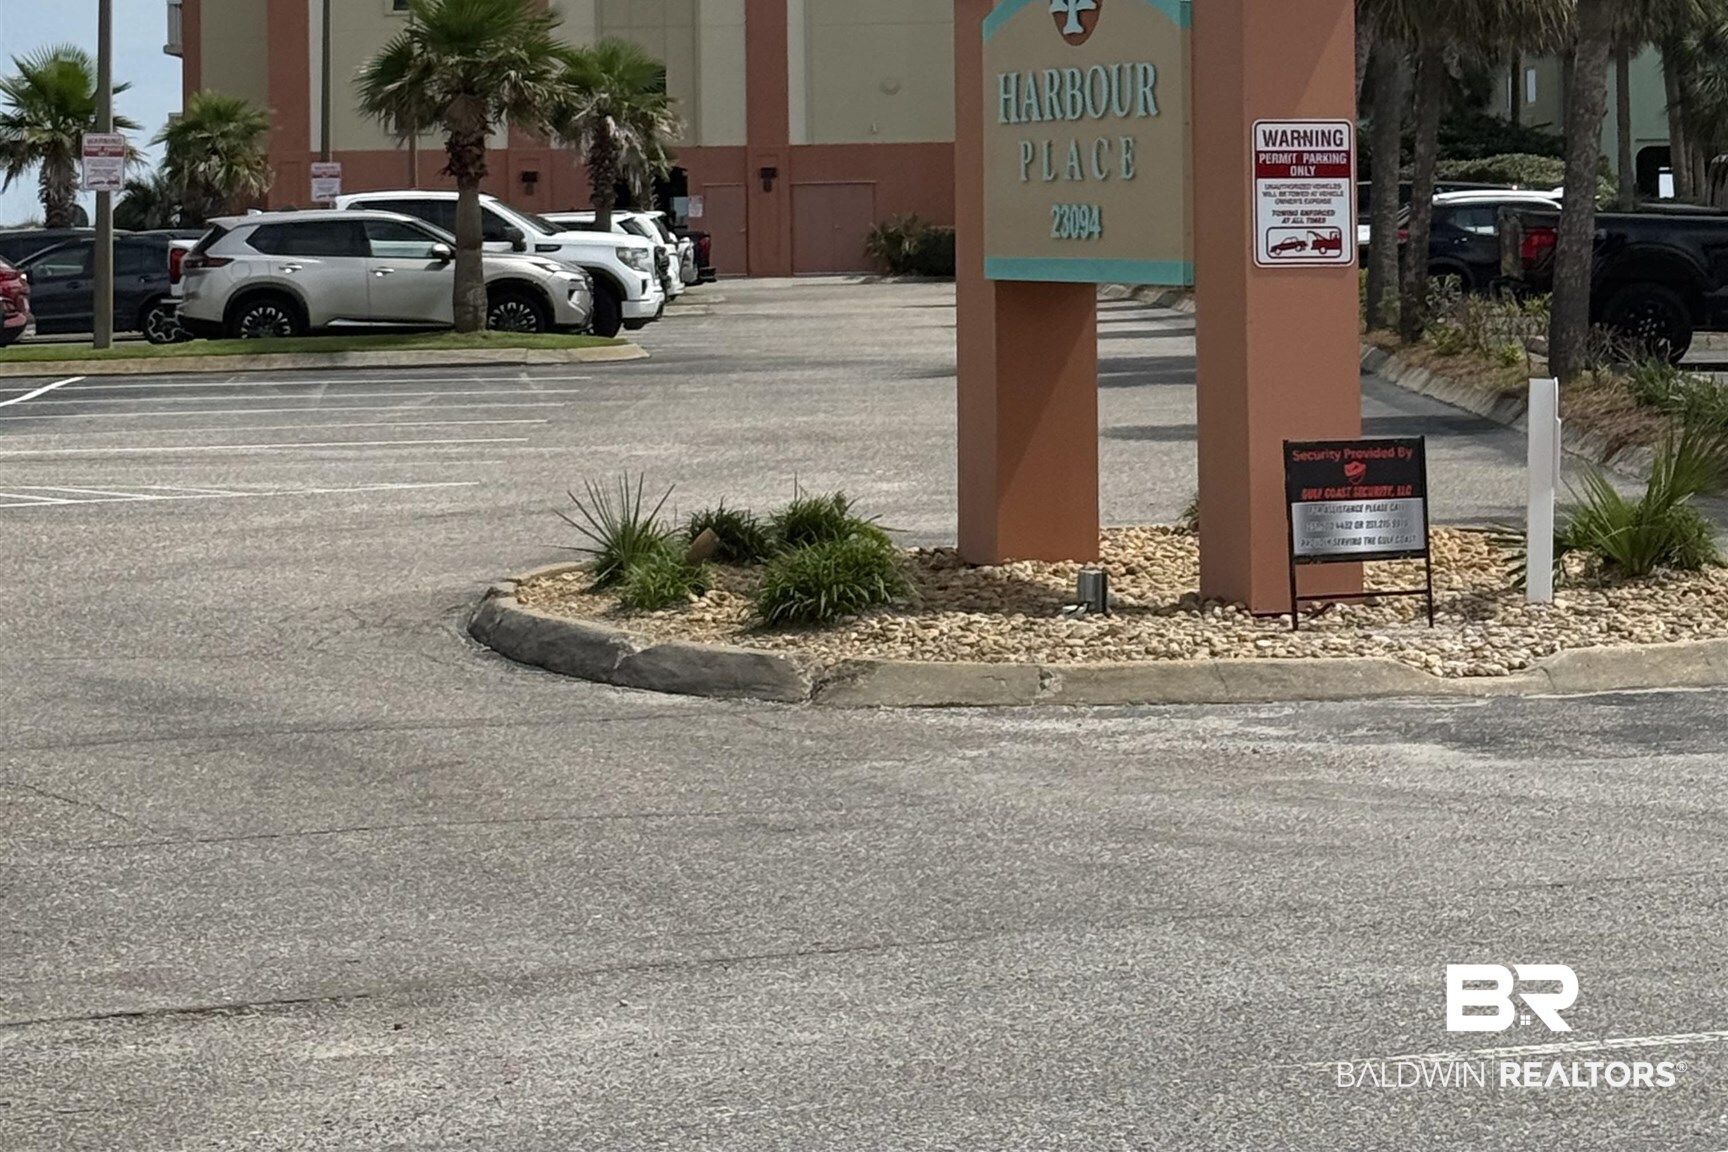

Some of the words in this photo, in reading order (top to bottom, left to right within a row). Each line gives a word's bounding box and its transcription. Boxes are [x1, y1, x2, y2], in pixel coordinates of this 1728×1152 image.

[998, 62, 1159, 124] HARBOUR
[1262, 129, 1344, 148] WARNING
[1019, 136, 1137, 182] PLACE
[1259, 152, 1298, 164] PERMIT
[1303, 152, 1348, 164] PARKING
[1290, 165, 1317, 177] ONLY
[1050, 204, 1102, 240] 23094
[1292, 449, 1341, 462] Security
[1344, 447, 1395, 459] Provided
[1397, 446, 1413, 461] By
[1324, 487, 1351, 498] COAST
[1397, 484, 1413, 496] LLC
